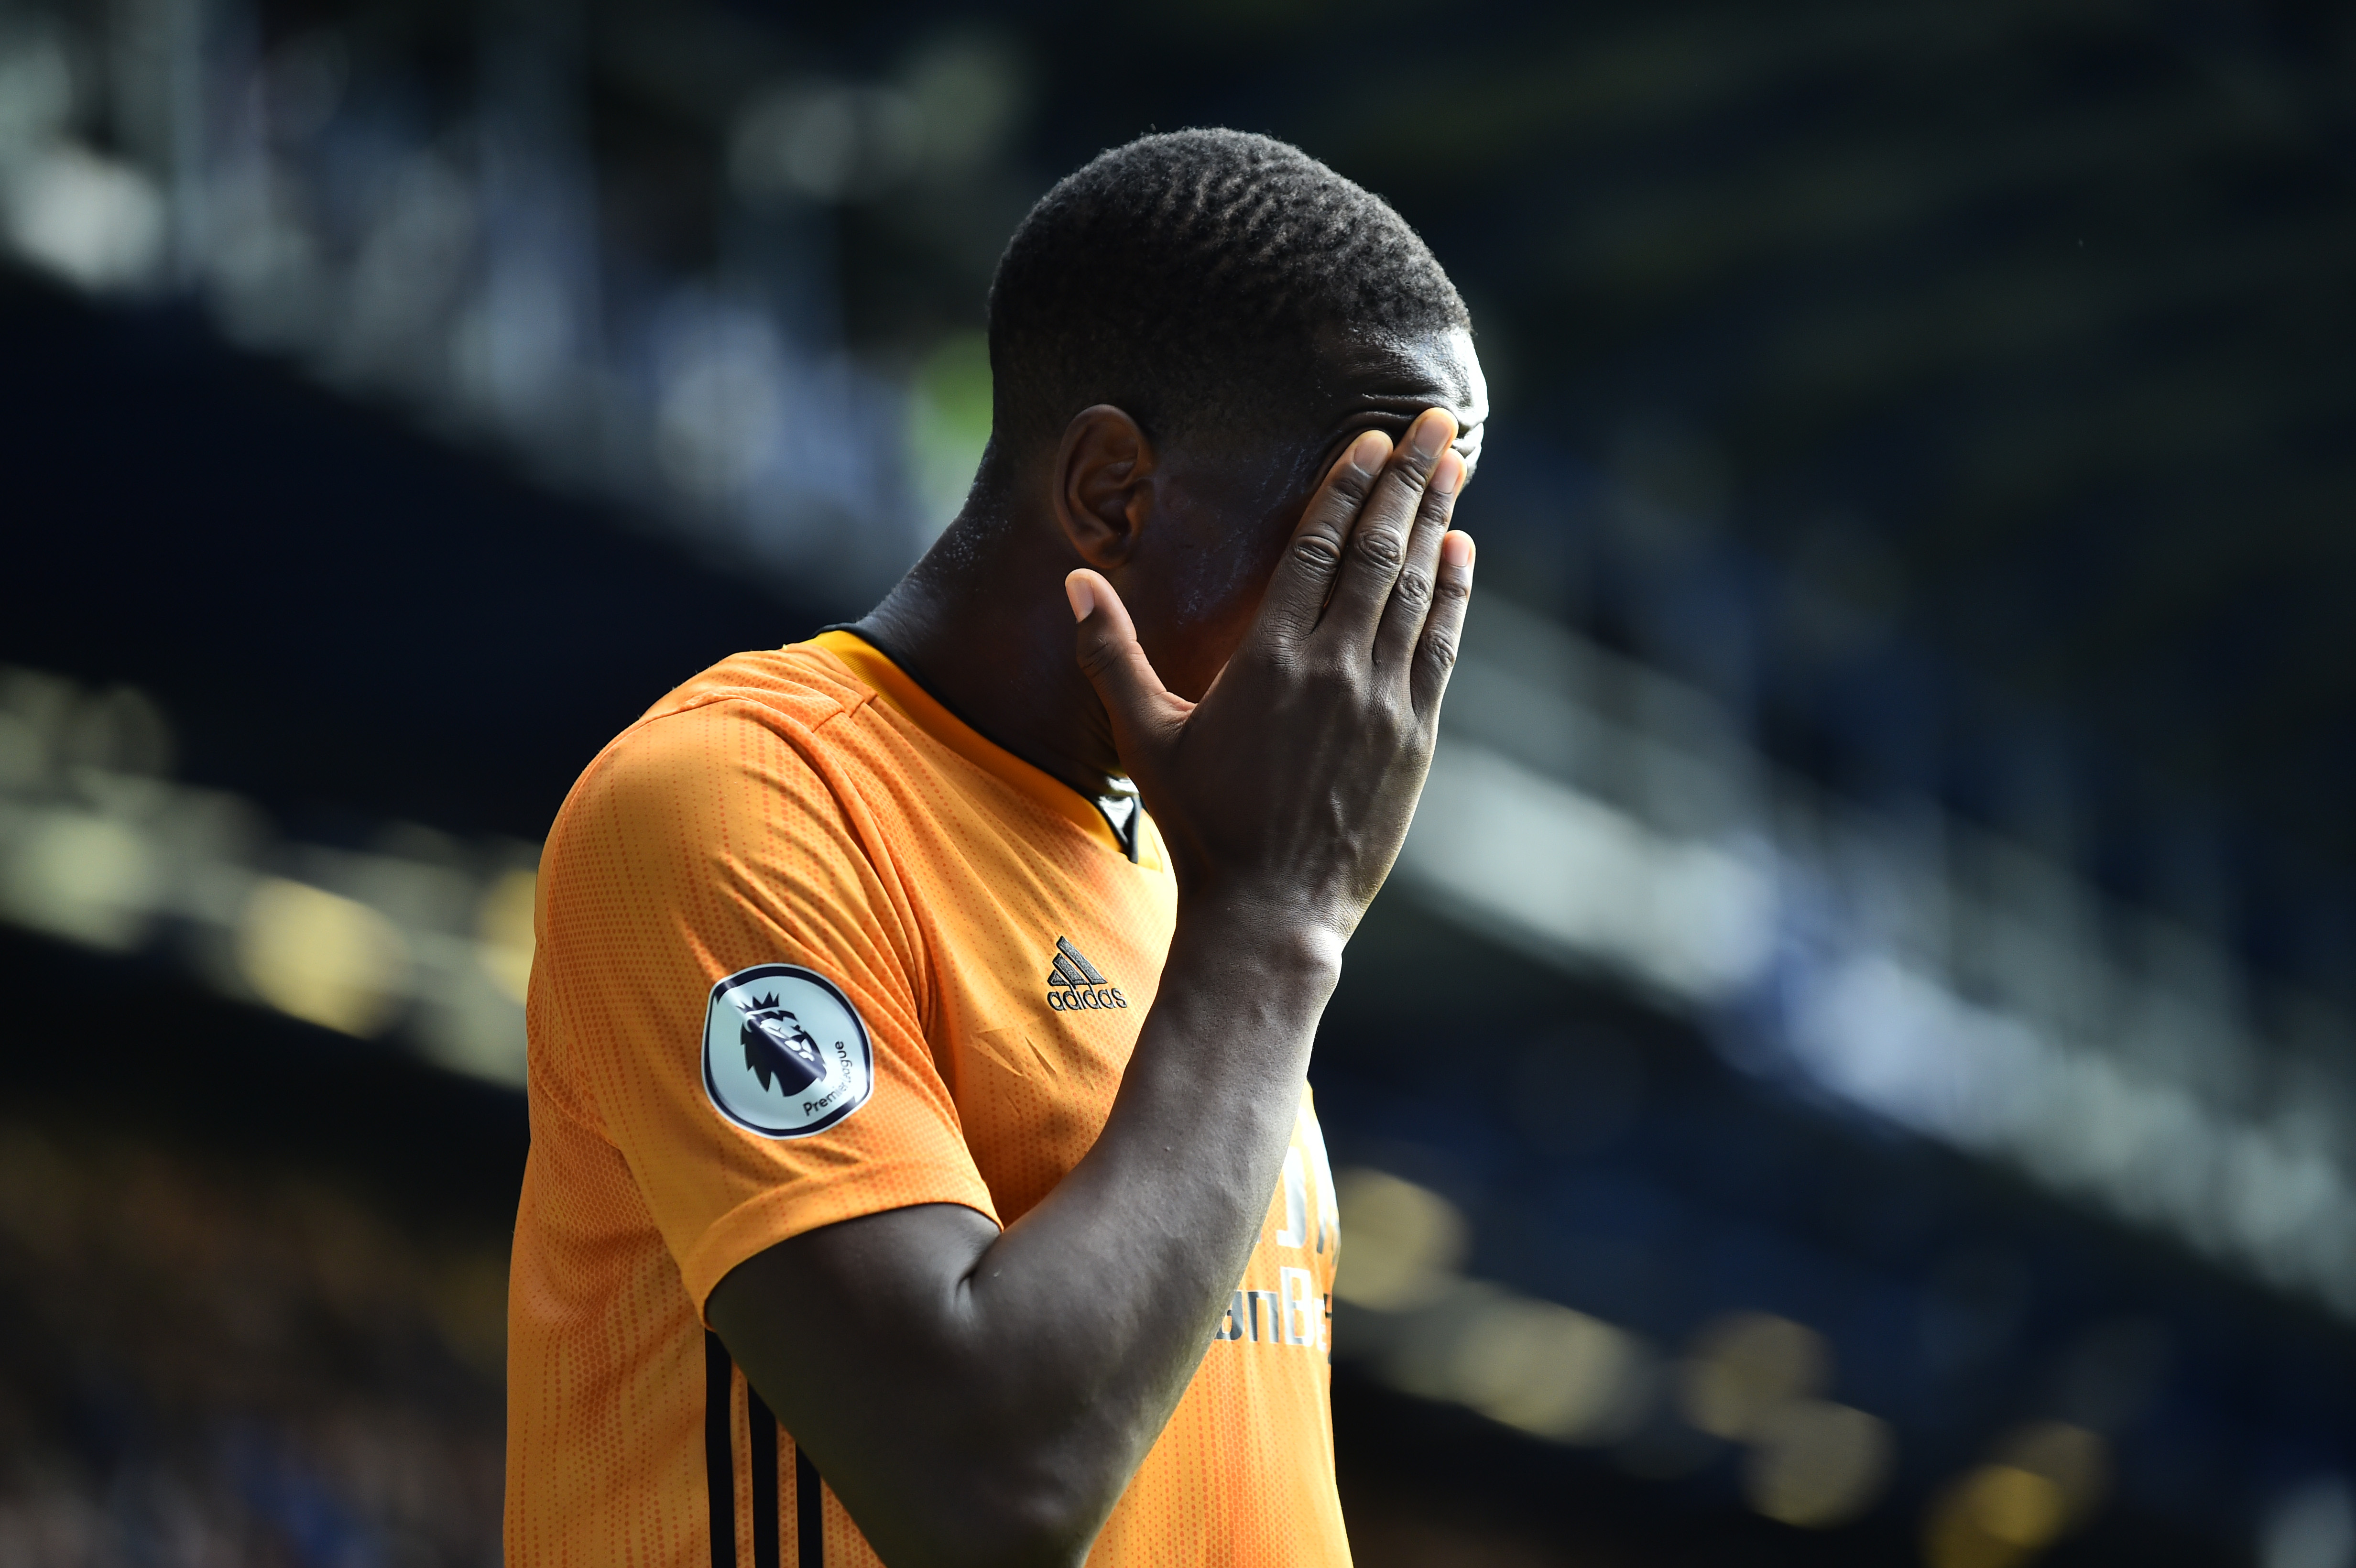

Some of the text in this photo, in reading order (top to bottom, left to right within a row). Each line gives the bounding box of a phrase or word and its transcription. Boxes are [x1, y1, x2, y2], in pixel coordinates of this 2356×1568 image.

[1047, 982, 1127, 1011] adidas
[803, 1040, 853, 1117] Premier League
